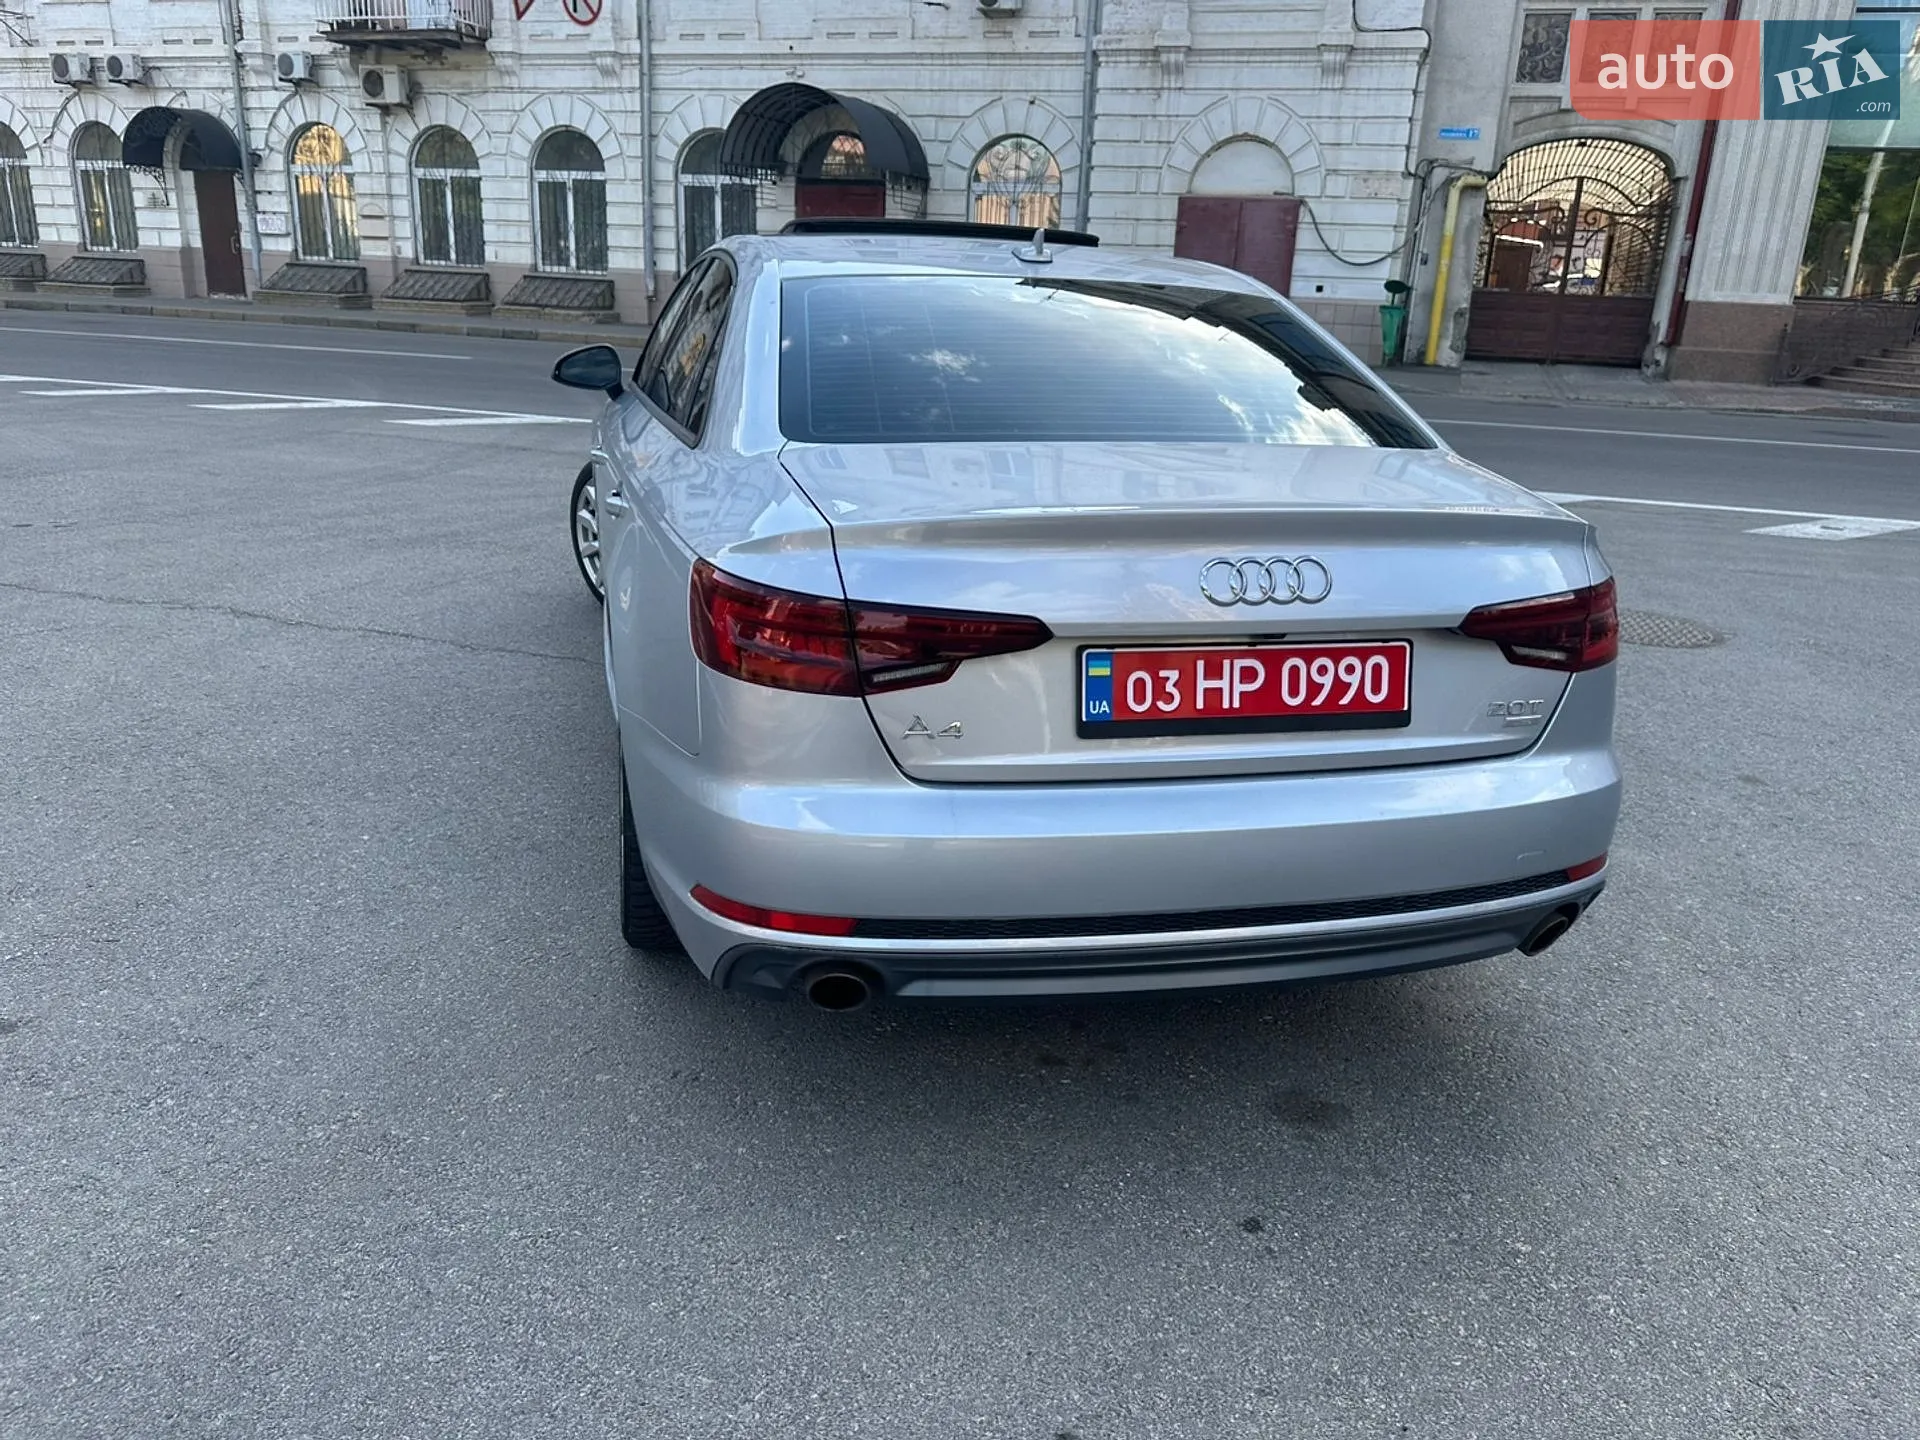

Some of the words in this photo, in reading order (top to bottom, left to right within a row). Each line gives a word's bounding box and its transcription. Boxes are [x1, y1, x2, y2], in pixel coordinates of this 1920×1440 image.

[1126, 669, 1182, 713] 03
[1195, 658, 1266, 709] HP
[1281, 654, 1390, 707] 0990
[1089, 700, 1110, 714] UA
[902, 712, 964, 740] A4
